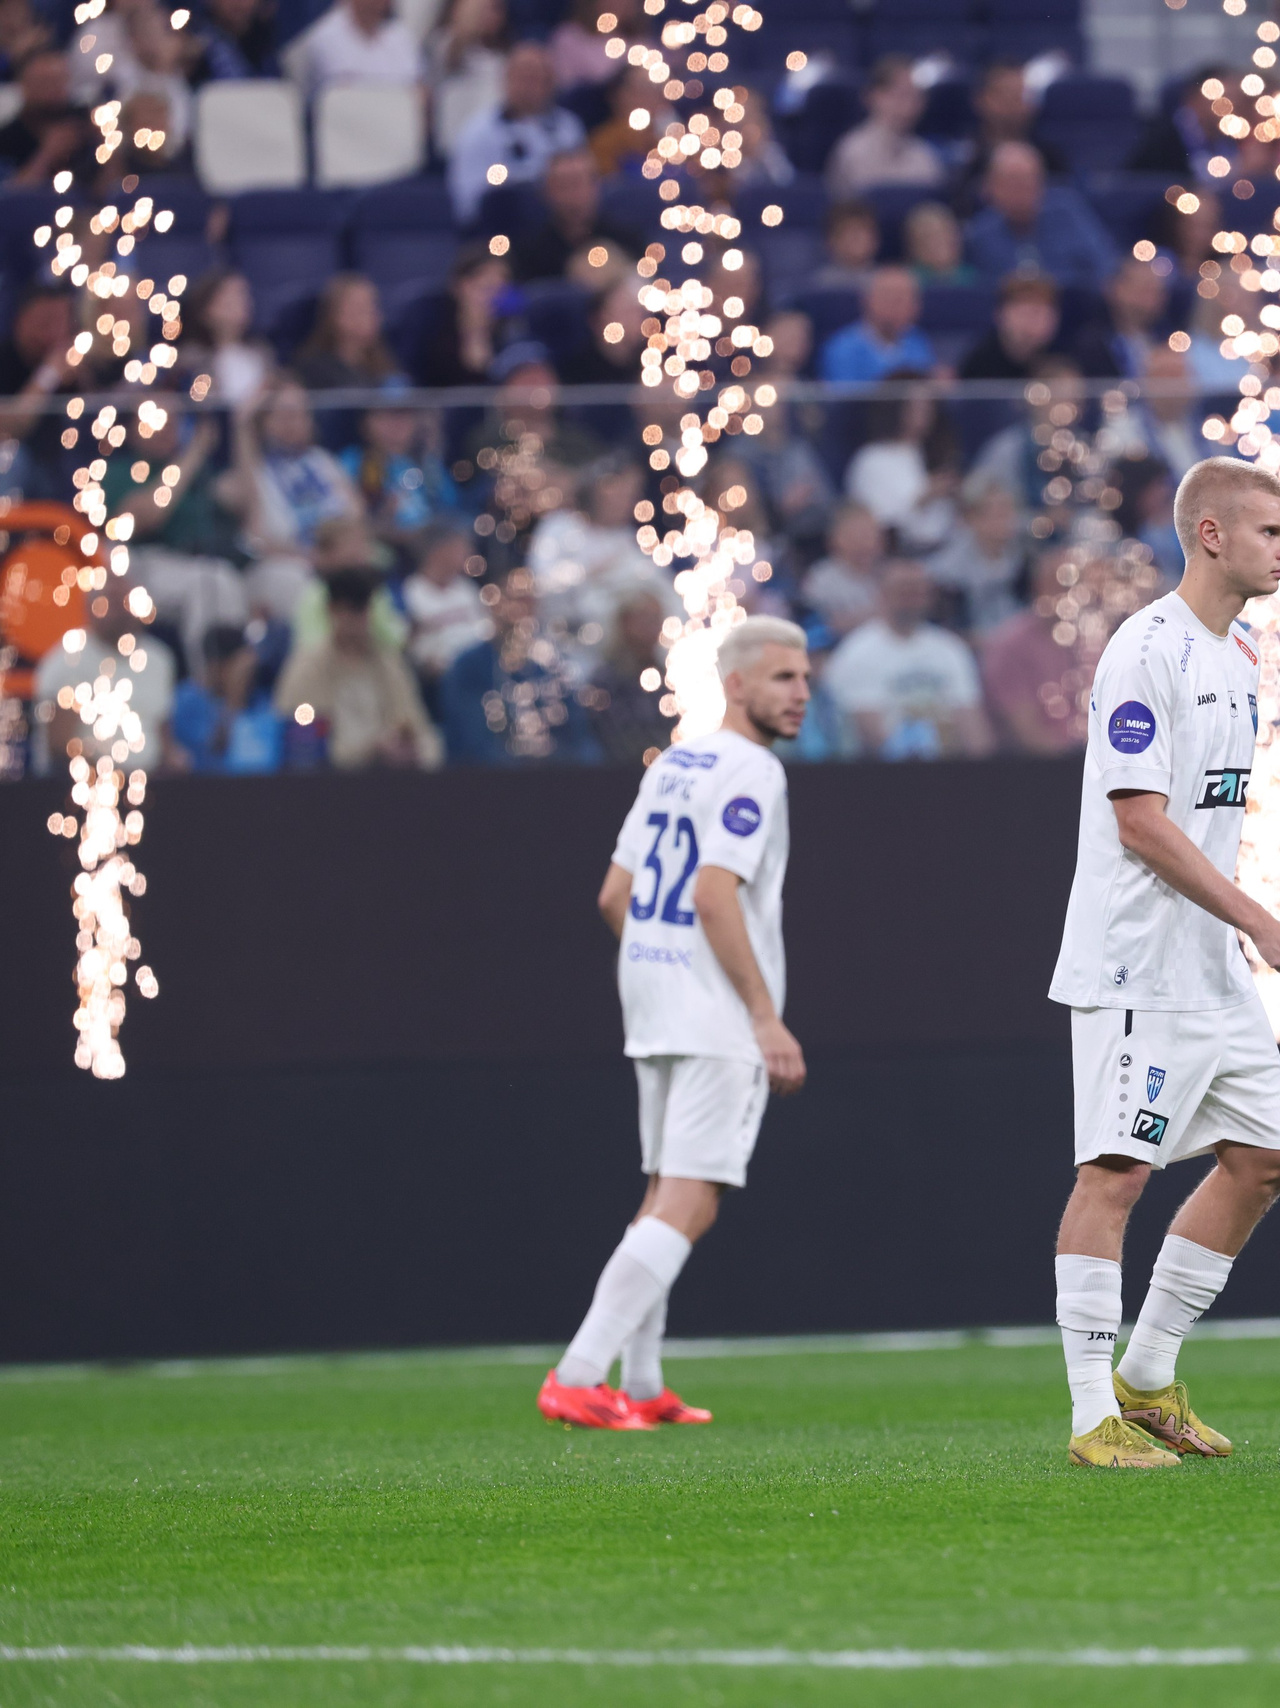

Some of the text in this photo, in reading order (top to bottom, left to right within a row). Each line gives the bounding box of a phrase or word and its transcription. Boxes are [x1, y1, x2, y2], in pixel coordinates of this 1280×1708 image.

[1197, 693, 1217, 706] JAKO
[1126, 719, 1151, 730] МИР
[630, 813, 699, 926] 32
